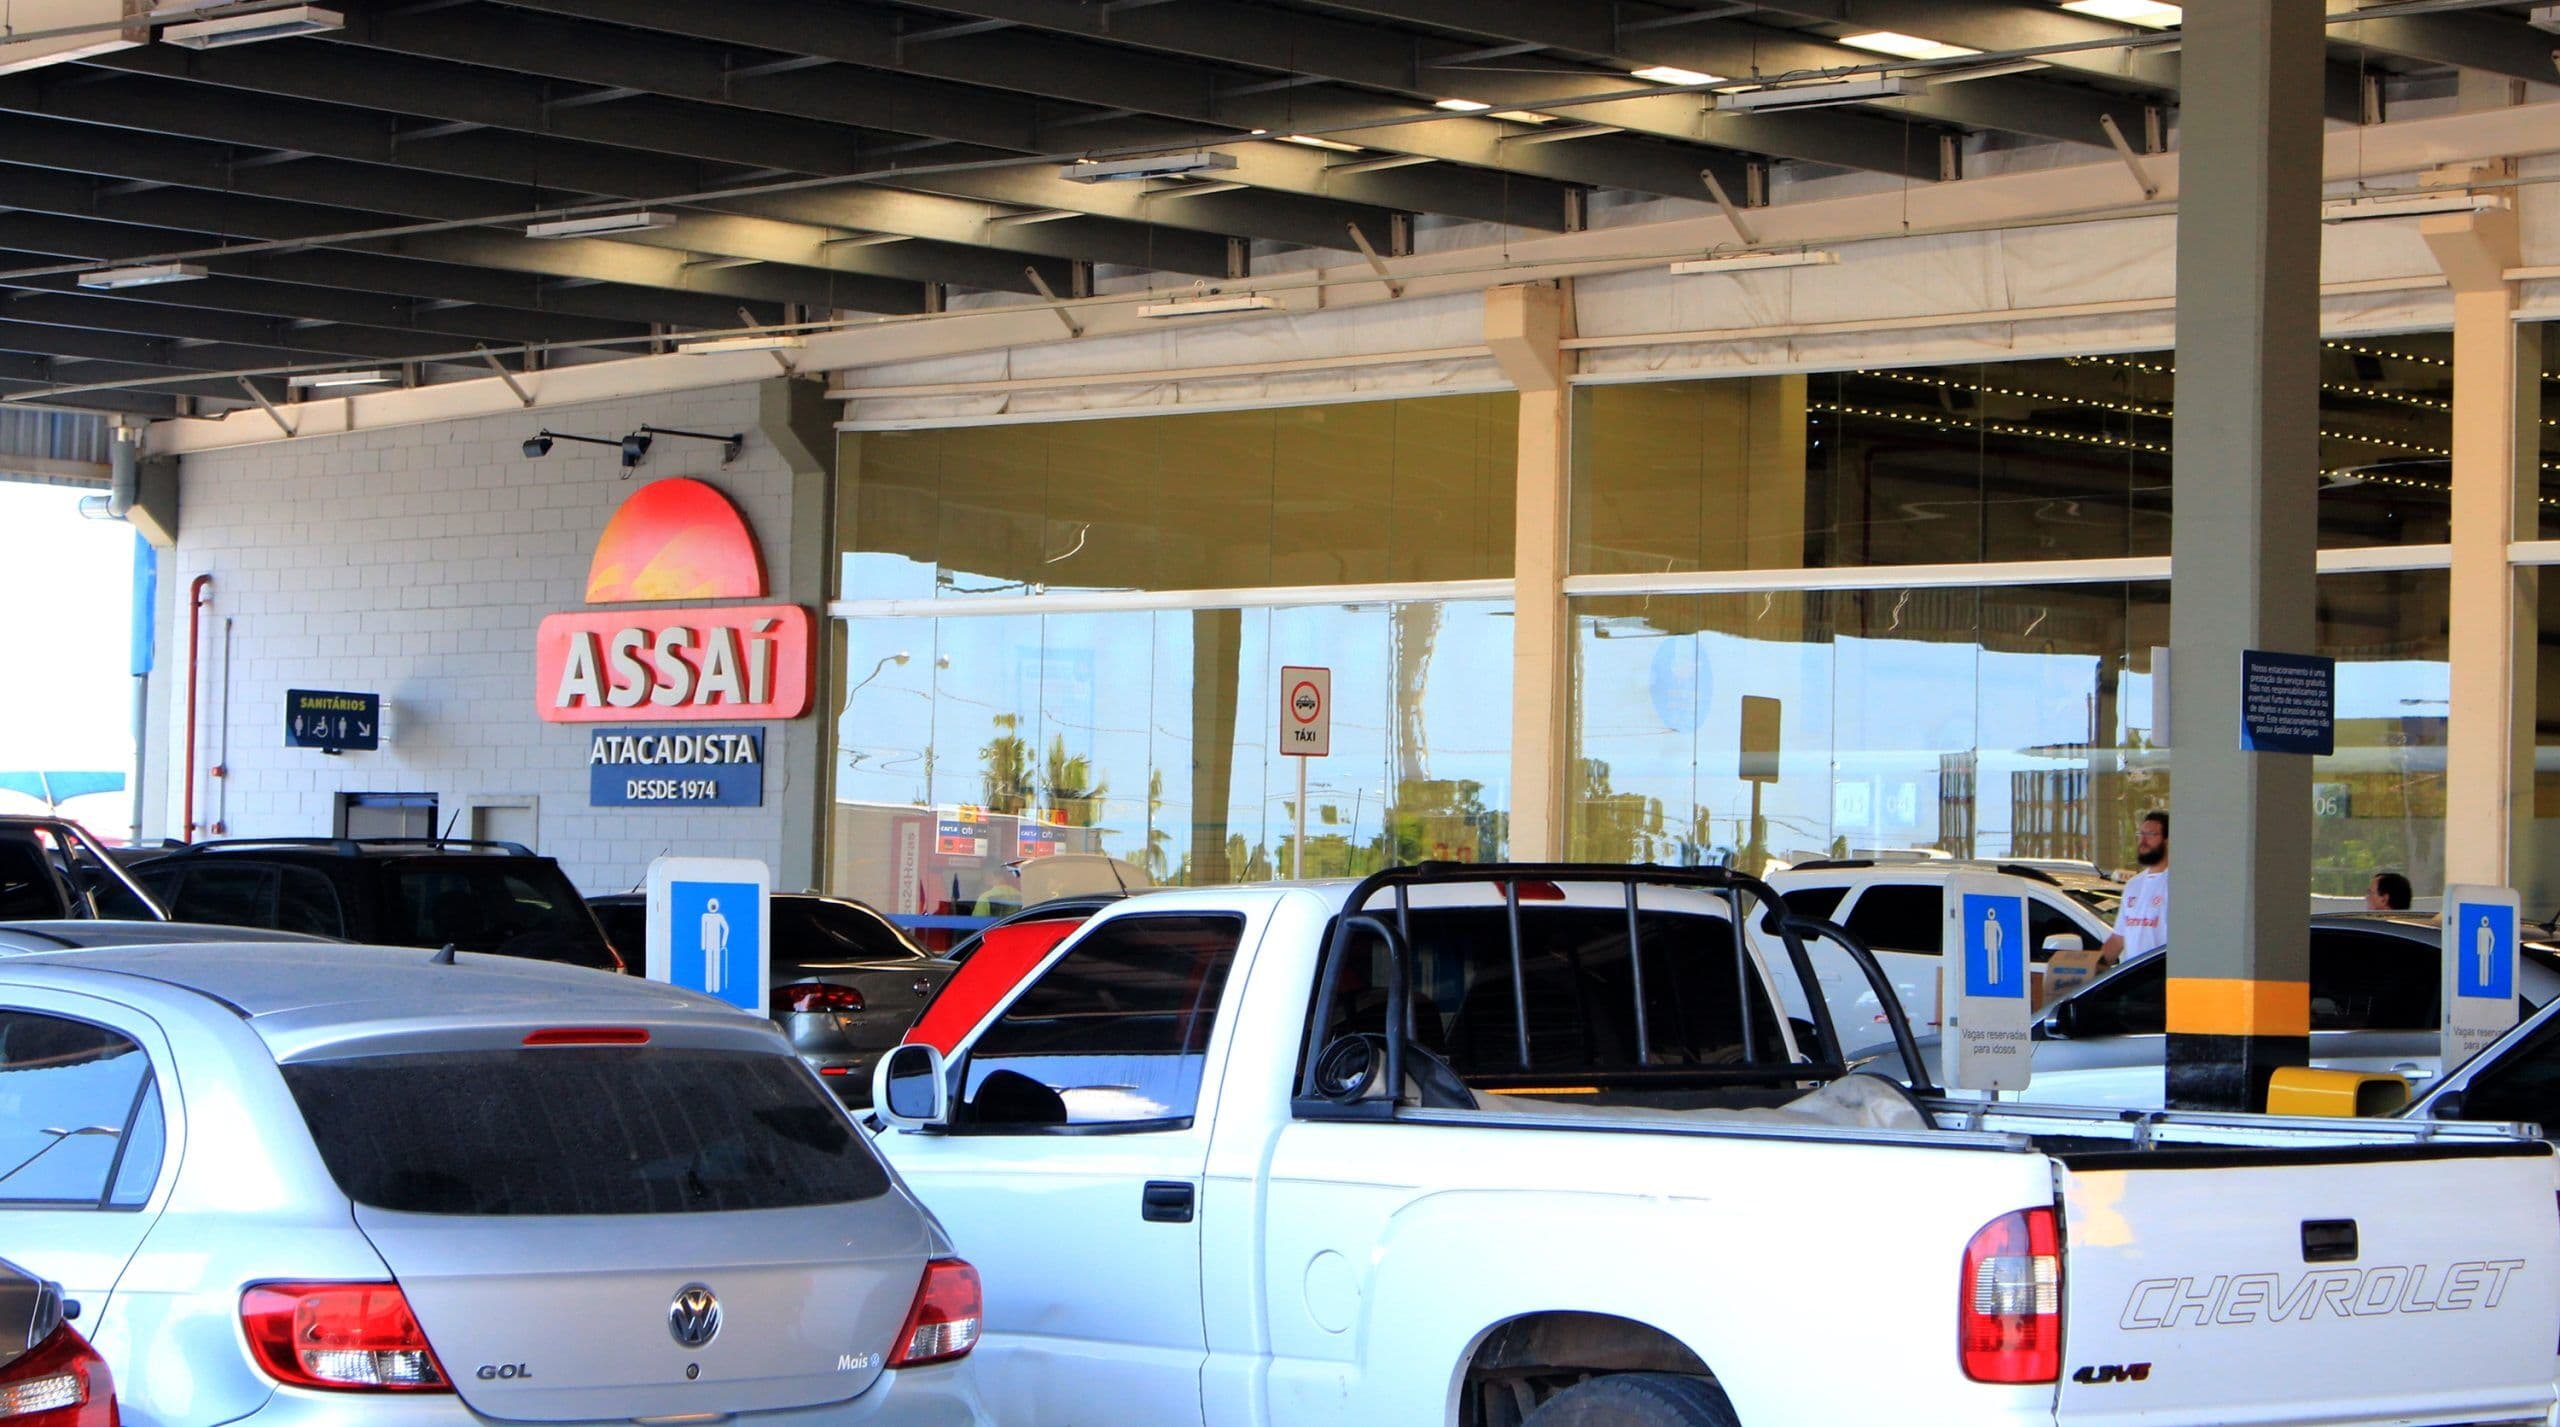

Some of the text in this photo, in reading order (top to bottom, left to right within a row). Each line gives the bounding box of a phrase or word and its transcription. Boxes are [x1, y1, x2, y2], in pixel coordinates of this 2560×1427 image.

[300, 696, 366, 711] SANITÁRIOS
[1294, 728, 1316, 741] TÁXI
[590, 734, 758, 765] ATACADISTA
[627, 780, 716, 799] DESDE 1974
[2314, 797, 2337, 816] 06
[1962, 1029, 2027, 1041] Vagas reservadas
[1973, 1044, 2017, 1055] para idosos
[2119, 1258, 2525, 1331] CHEVROLET
[837, 1352, 868, 1371] Mais
[476, 1362, 532, 1380] GOL
